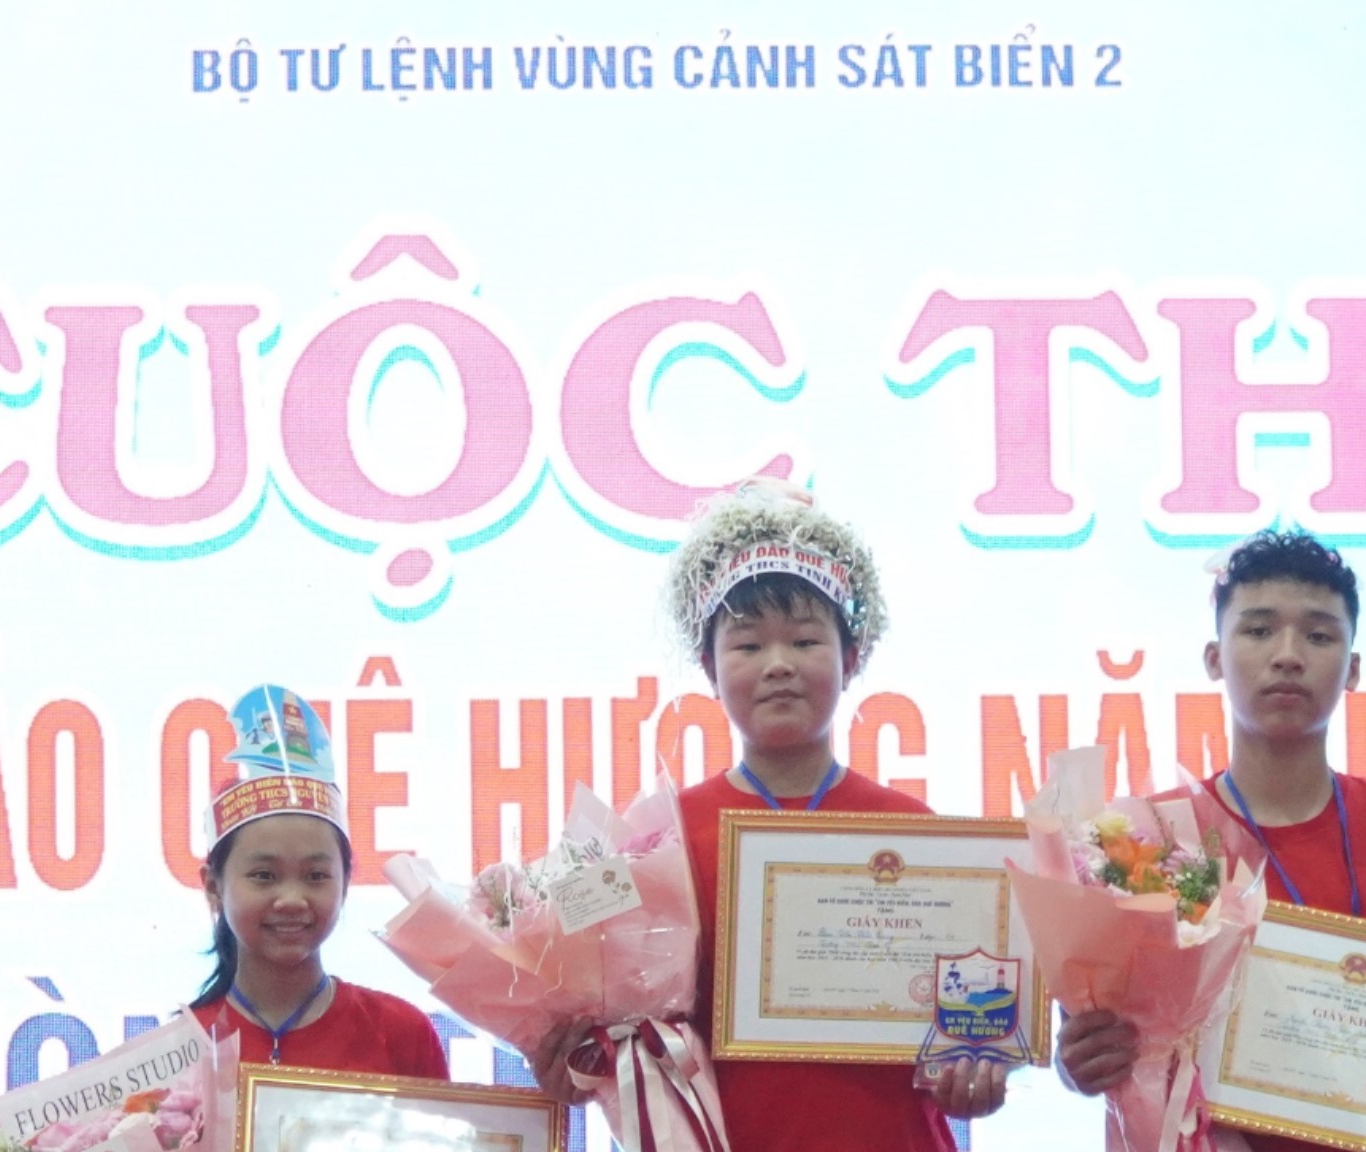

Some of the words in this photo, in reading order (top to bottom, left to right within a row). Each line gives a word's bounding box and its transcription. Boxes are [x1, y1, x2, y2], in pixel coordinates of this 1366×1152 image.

[192, 38, 259, 103] BỘ
[280, 42, 347, 93] TƯ
[361, 37, 492, 102] LỆNH
[513, 33, 654, 91] VÙNG
[673, 29, 817, 91] CẢNH
[837, 31, 929, 89] SÁT
[955, 25, 1075, 89] BIỂN
[1094, 43, 1124, 88] 2
[160, 656, 416, 889] QÊ
[14, 1075, 124, 1137] FLOWERS
[125, 1038, 200, 1094] STUDIO
